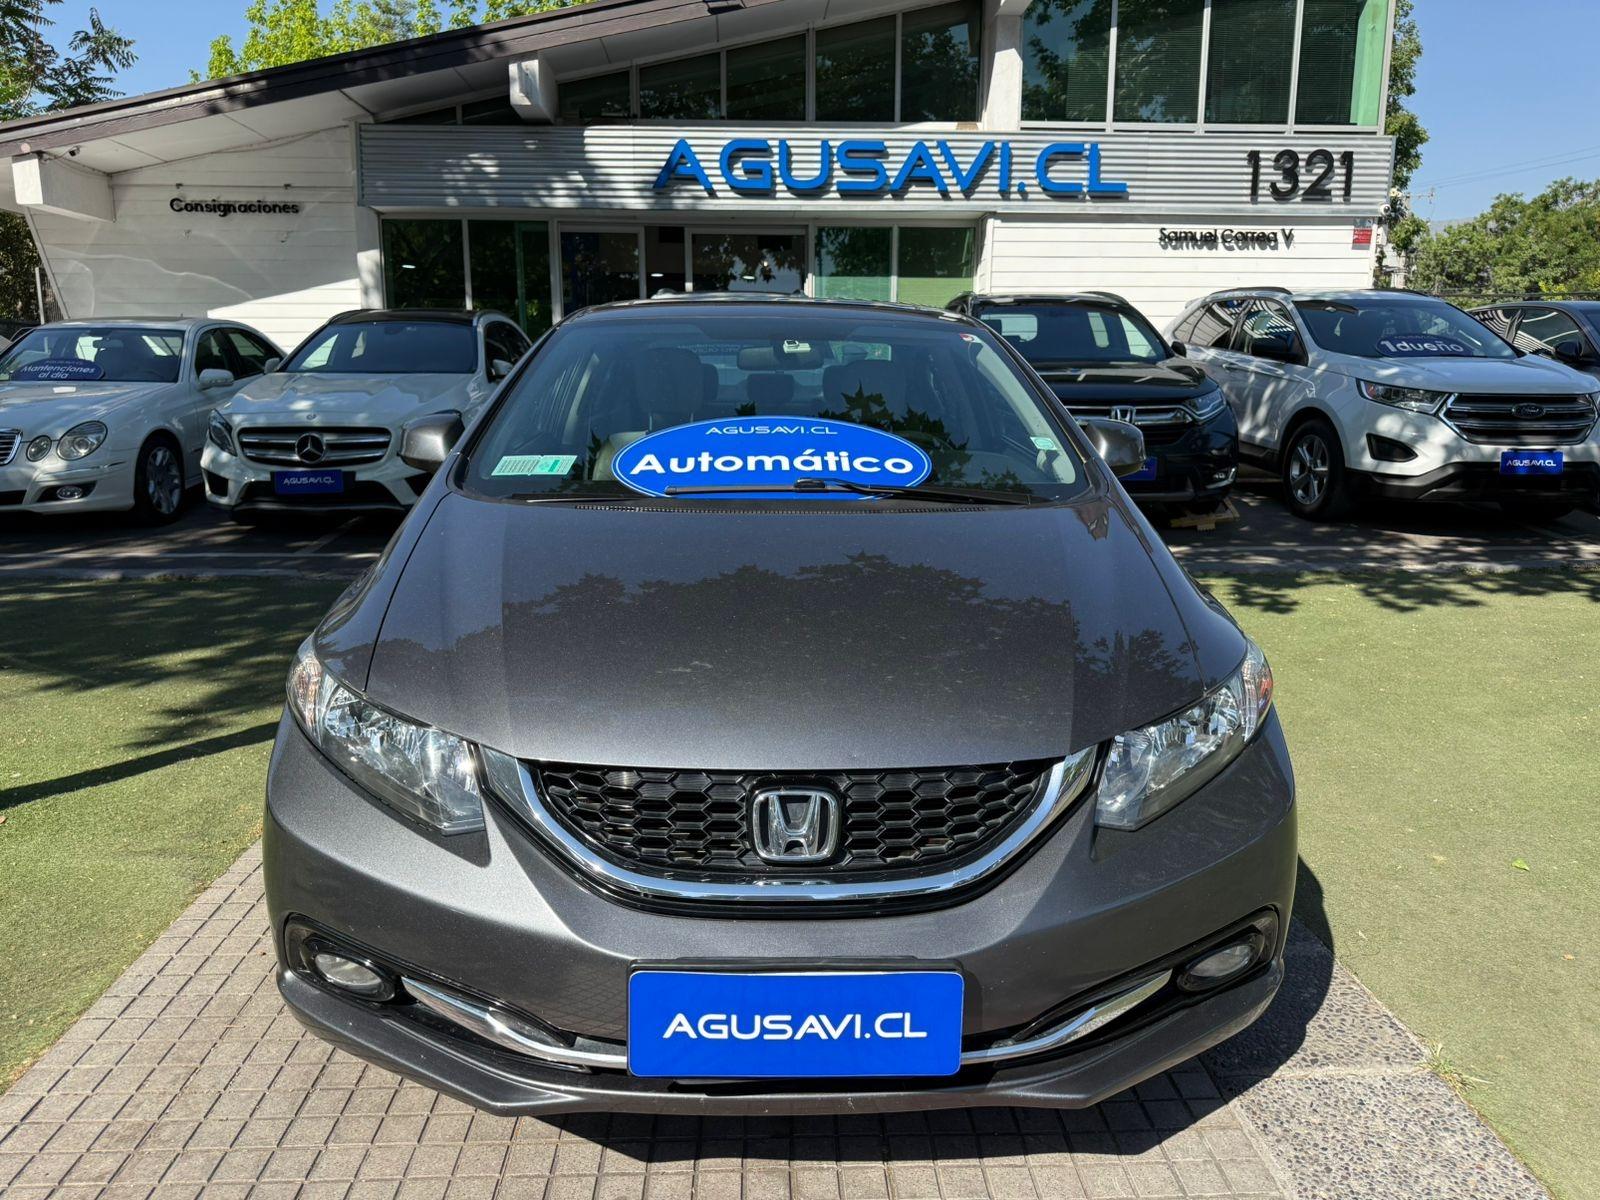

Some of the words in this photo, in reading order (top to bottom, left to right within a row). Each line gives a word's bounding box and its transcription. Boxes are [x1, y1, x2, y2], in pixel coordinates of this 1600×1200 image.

[653, 138, 1127, 194] AGUSAVI.CL
[1247, 149, 1354, 203] 1321
[169, 198, 299, 217] Consignaciones
[1159, 228, 1217, 245] Samuel
[1221, 228, 1277, 245] Correa
[1281, 228, 1294, 245] V
[20, 364, 96, 374] Mantenciones
[38, 371, 49, 379] al
[705, 425, 838, 435] AGUSAVI.CL
[630, 449, 913, 474] Automático
[1506, 459, 1557, 467] AGUSAVI.CL
[283, 476, 336, 485] AGUSAVI.CL
[662, 1012, 928, 1041] AGUSAVI.CL
